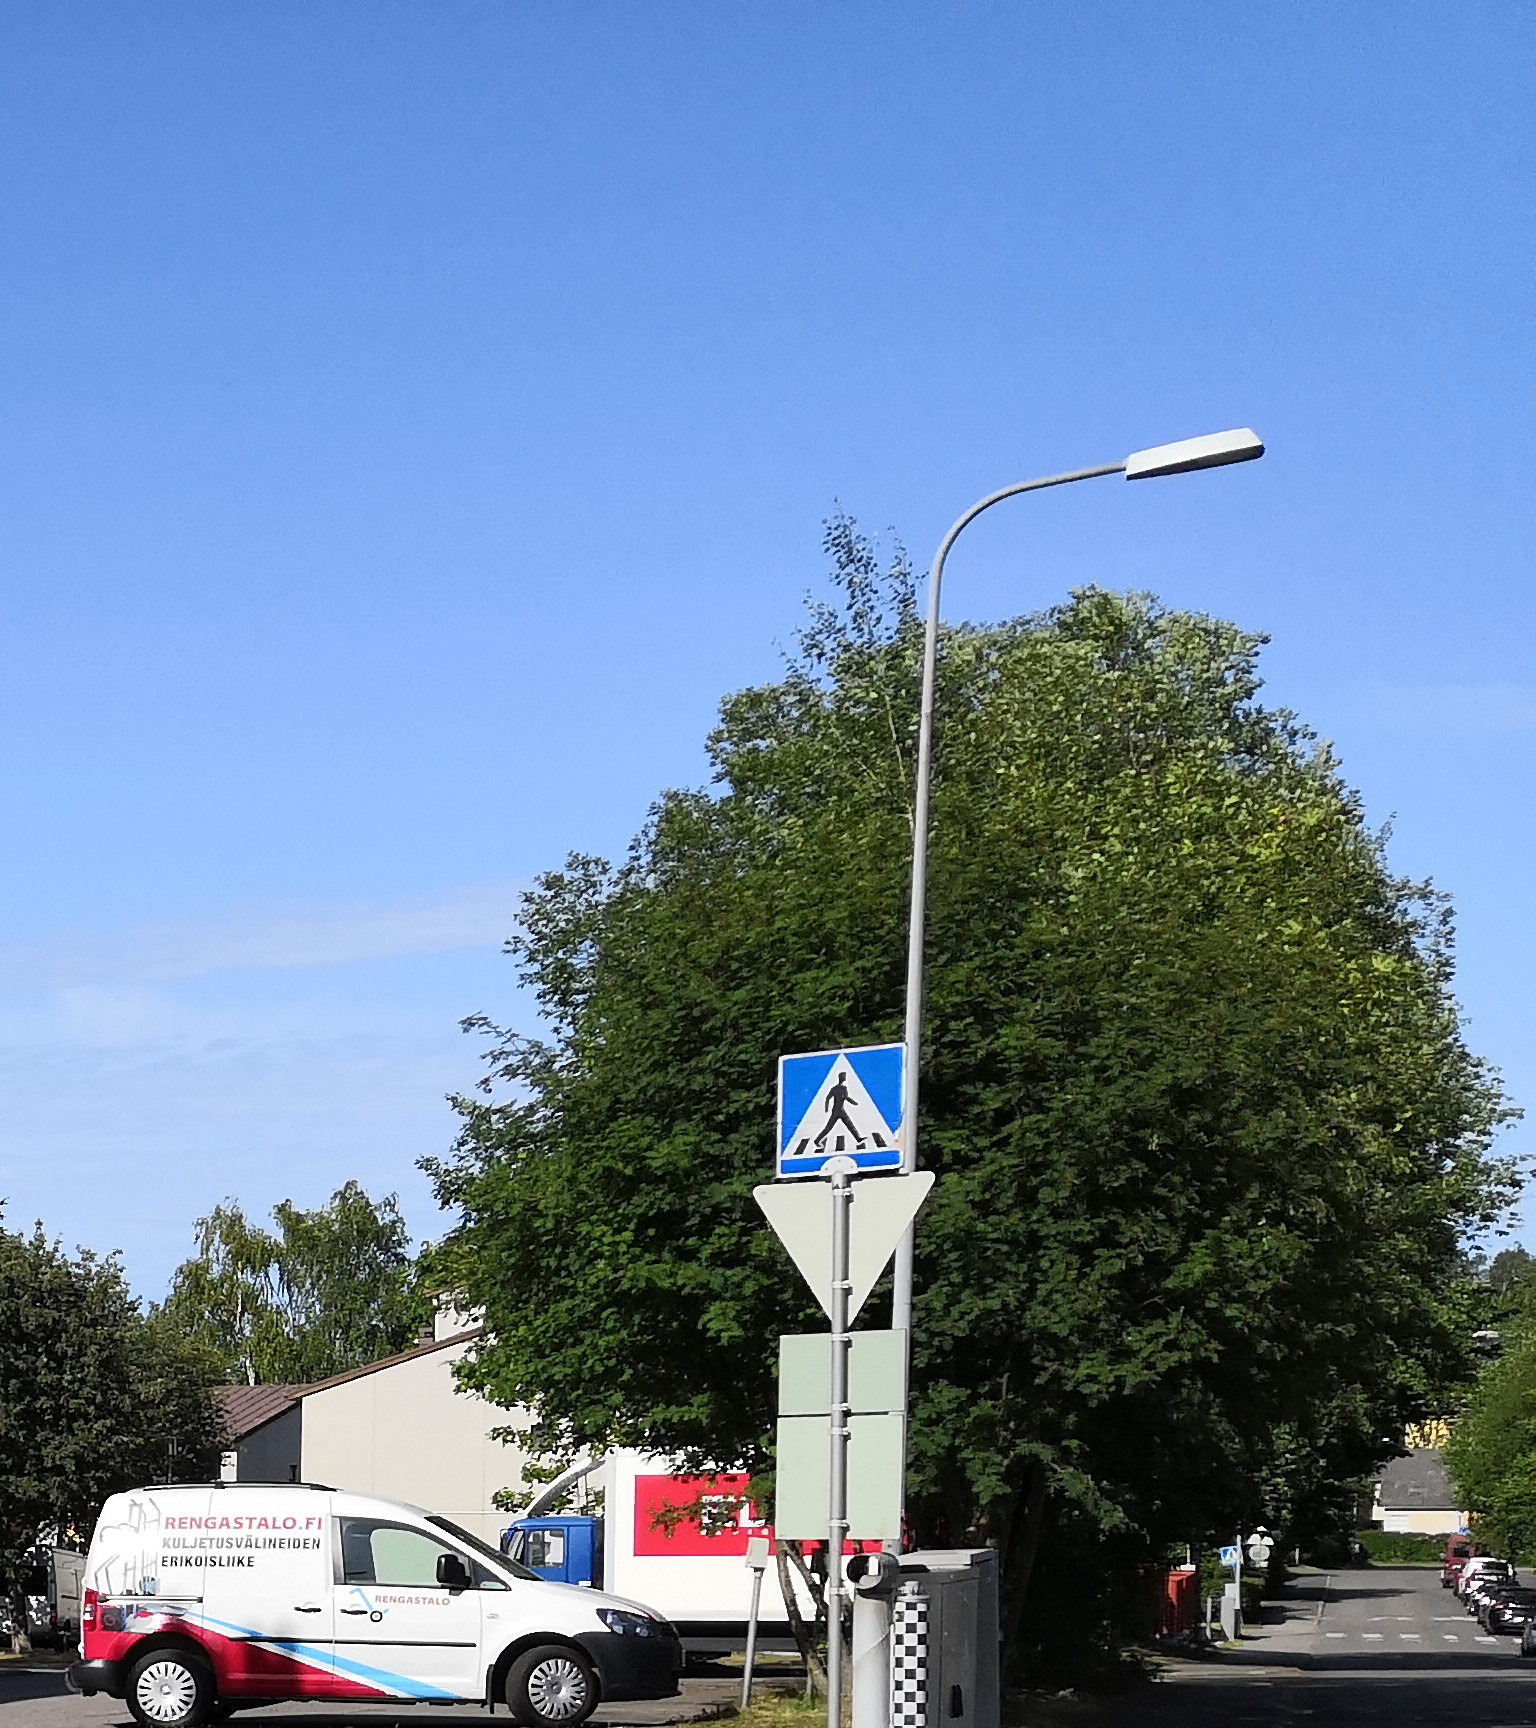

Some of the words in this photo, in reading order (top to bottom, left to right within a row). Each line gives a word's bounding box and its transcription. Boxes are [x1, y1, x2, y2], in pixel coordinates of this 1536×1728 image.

[164, 1516, 322, 1530] RENGASTALO.FI
[162, 1534, 321, 1550] KULJETUSVÄLINEIDEN
[161, 1555, 255, 1568] ERIKOISLIIKE
[374, 1594, 451, 1606] RENGASTALO
